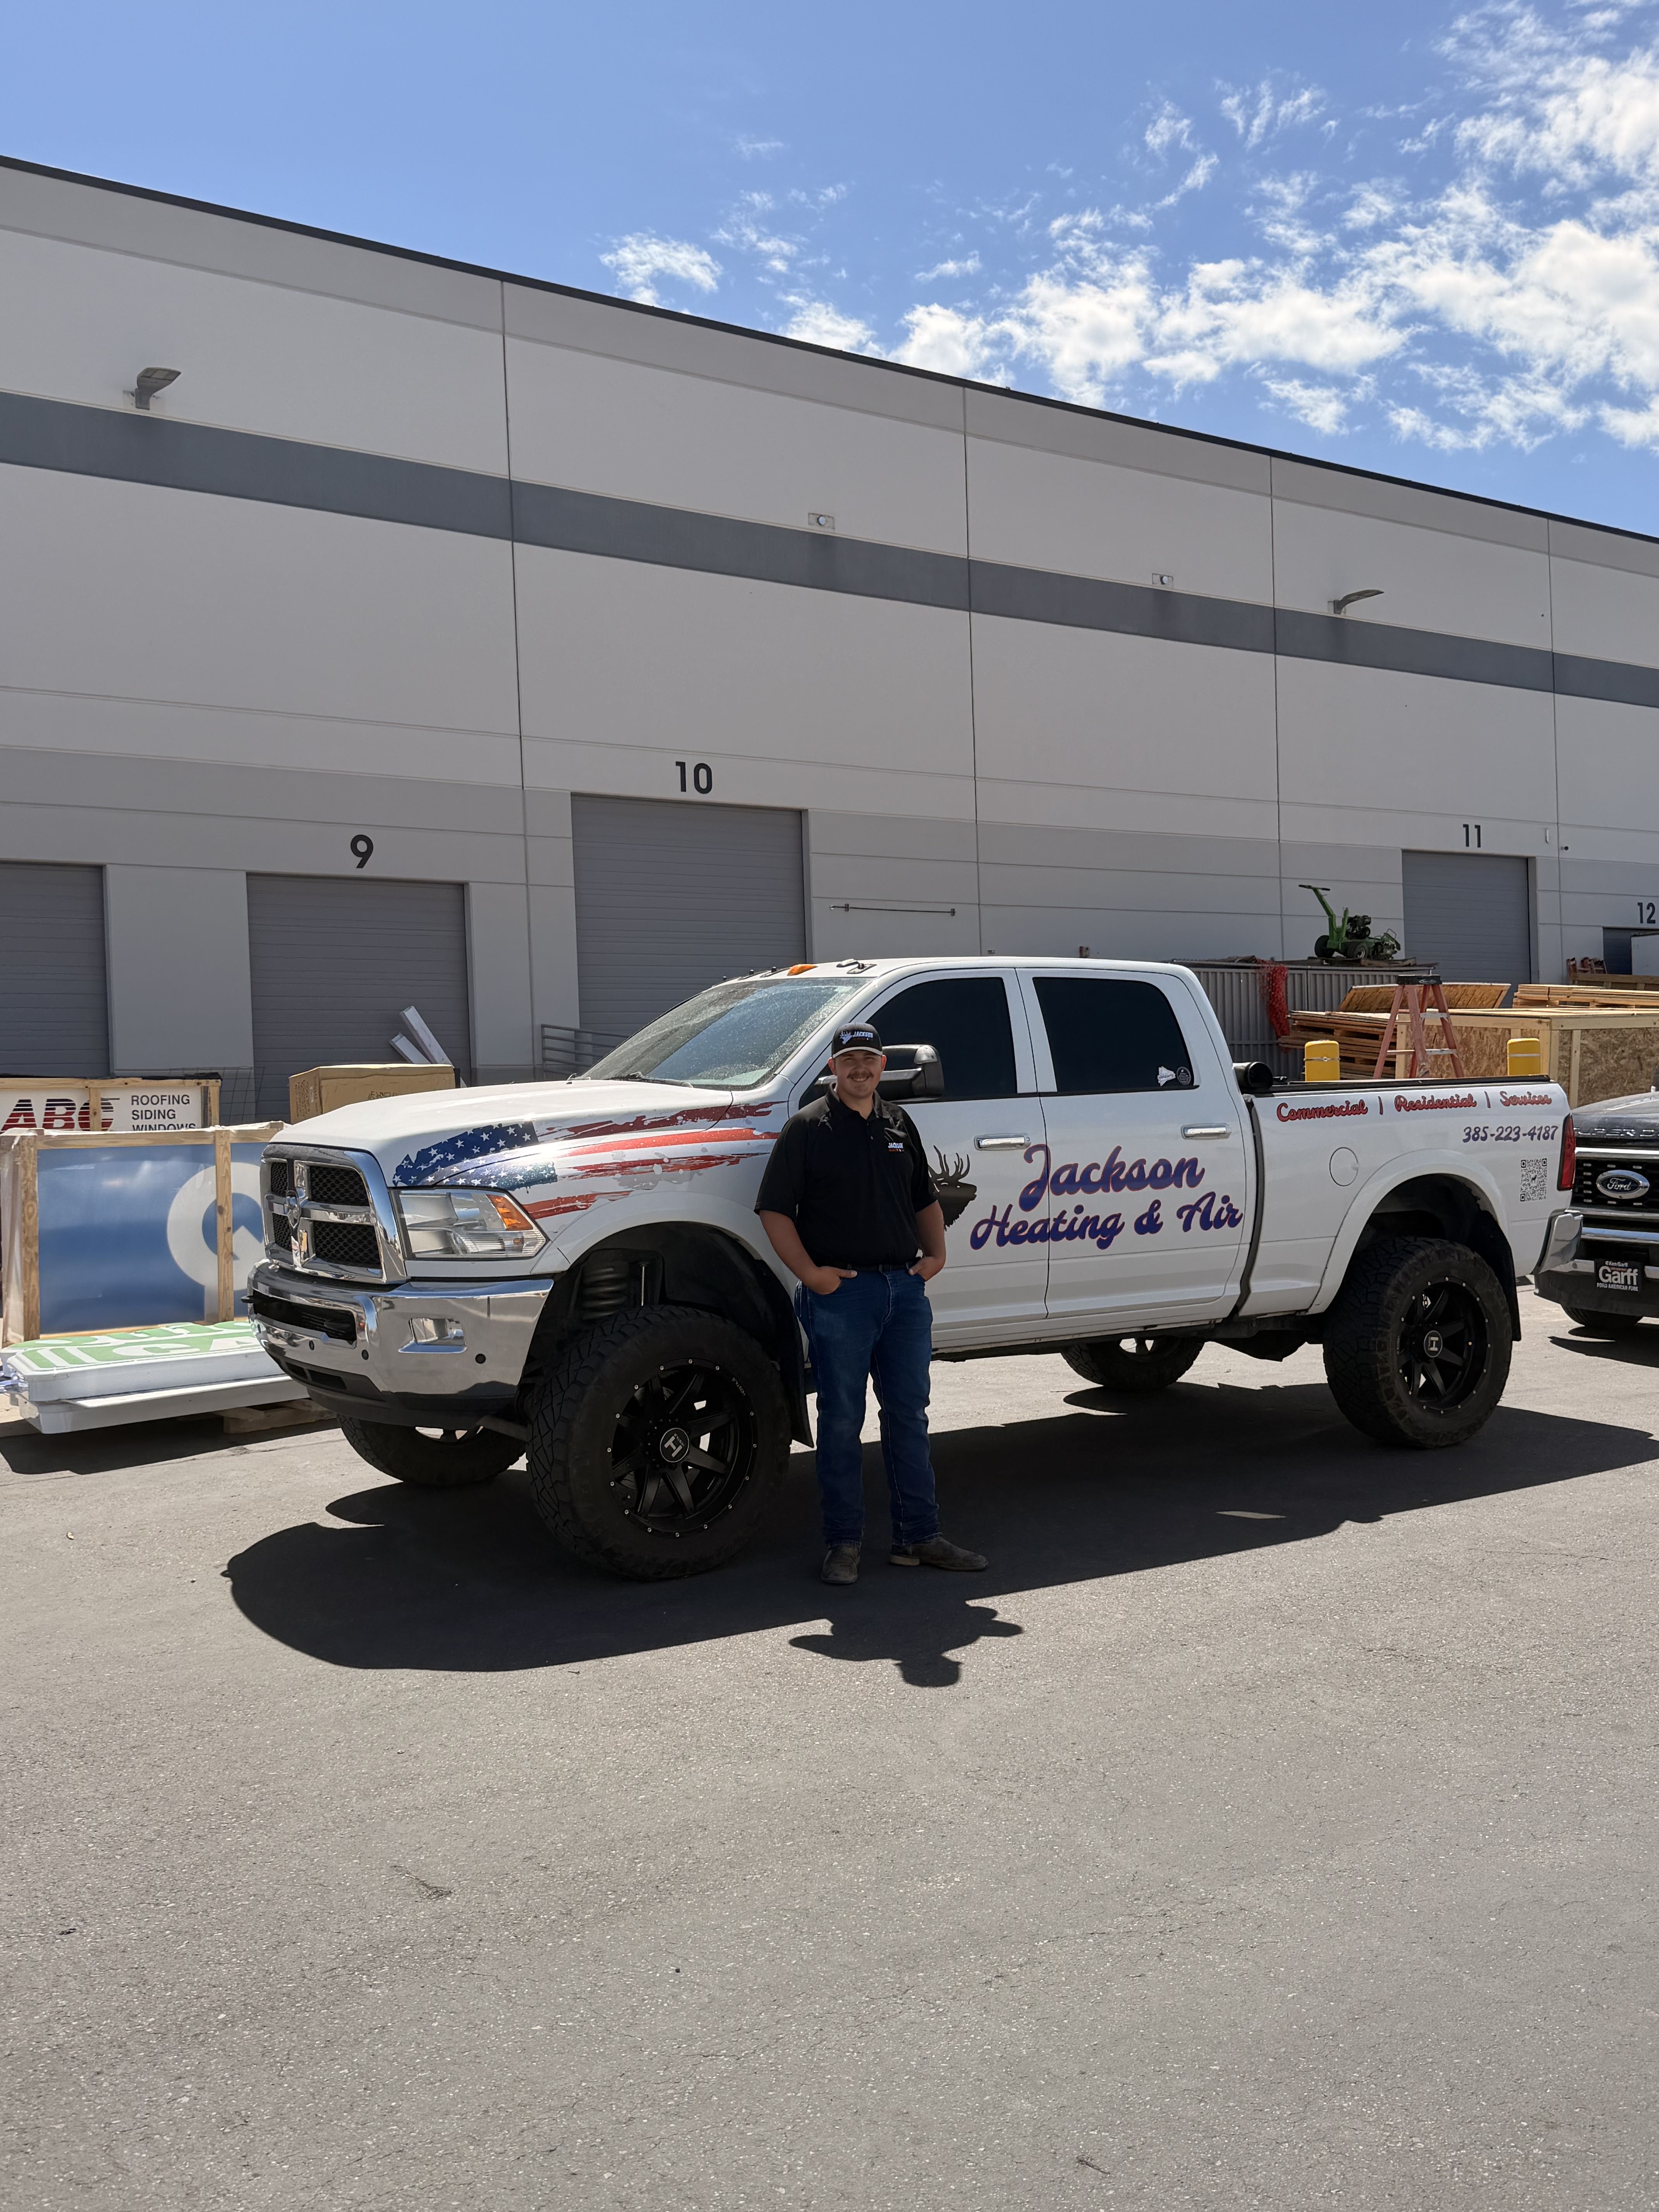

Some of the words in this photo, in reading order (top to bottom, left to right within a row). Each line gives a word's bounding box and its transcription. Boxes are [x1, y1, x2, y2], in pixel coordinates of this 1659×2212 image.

[675, 761, 712, 794] 10
[1463, 824, 1481, 848] 11
[350, 834, 373, 868] 9
[1637, 902, 1656, 924] 12
[131, 1094, 190, 1105] ROOFING
[1276, 1099, 1368, 1122] Commercial
[1395, 1094, 1477, 1112] Residential
[1499, 1091, 1552, 1106] Services
[1, 1098, 116, 1131] ABC
[132, 1109, 176, 1120] SIDING
[1462, 1125, 1558, 1143] 385-223-4187
[1018, 1144, 1205, 1211] Jackson
[1607, 1178, 1632, 1190] Ford
[970, 1204, 1125, 1250] Heating
[1134, 1199, 1163, 1235] &
[1176, 1191, 1243, 1232] Air
[1599, 1266, 1638, 1285] Garff
